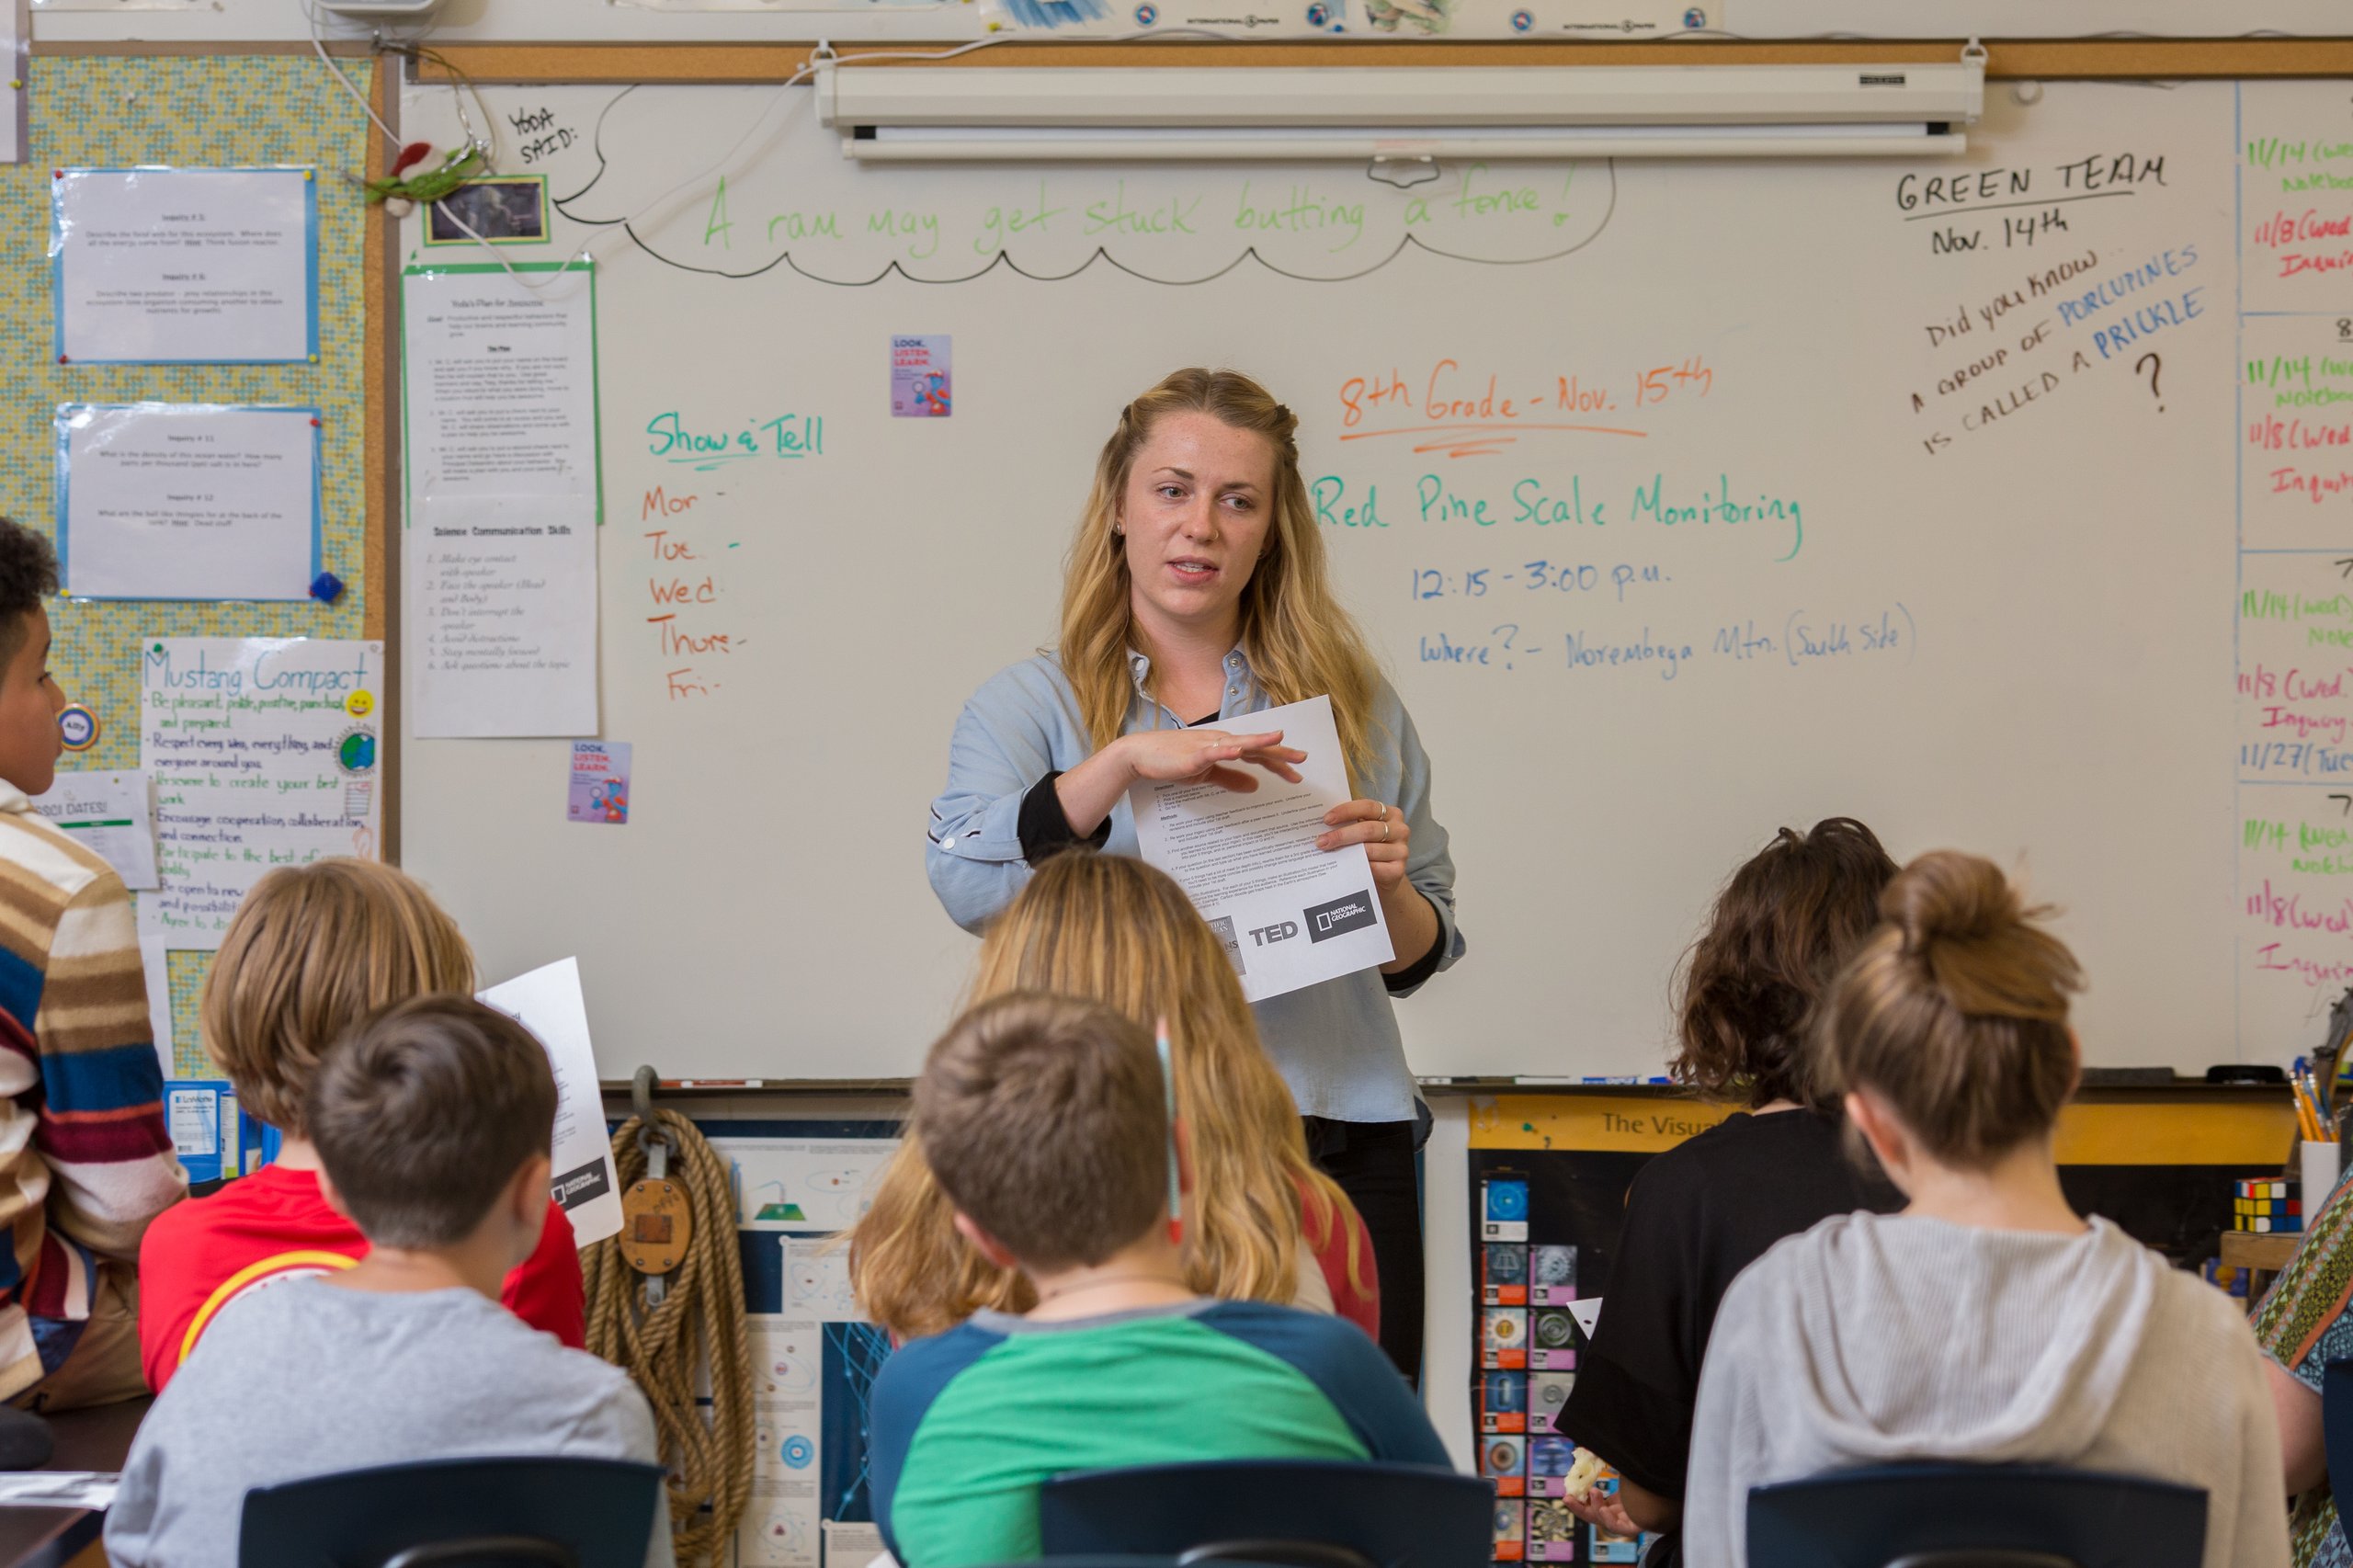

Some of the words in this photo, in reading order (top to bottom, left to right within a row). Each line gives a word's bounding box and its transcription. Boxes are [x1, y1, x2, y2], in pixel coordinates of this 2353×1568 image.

[508, 107, 553, 136] YODA
[521, 128, 578, 164] SAID:
[1897, 168, 2030, 210] GREEN
[2055, 153, 2166, 189] TEAM
[705, 175, 733, 249] A
[767, 210, 844, 244] ram
[868, 208, 939, 259] may
[974, 179, 1068, 256] get
[1083, 179, 1202, 236] stuck
[1234, 180, 1365, 254] butting
[1404, 199, 1432, 226] a
[1932, 228, 1988, 255] Nov.
[2004, 208, 2068, 247] 14th
[1911, 392, 1924, 414] A
[1938, 348, 2008, 395] GROUP
[2021, 319, 2052, 352] OF
[2057, 244, 2199, 327] PORCUPINES
[1925, 305, 1972, 347] Did
[1980, 290, 2026, 331] you
[1923, 432, 1951, 455] IS
[1961, 371, 2060, 432] CALLED
[2071, 350, 2091, 373] A
[2093, 285, 2206, 359] PRICKLE
[2135, 351, 2165, 414] ?
[1340, 368, 1413, 427] 8th
[1427, 358, 1519, 420] Grade
[1559, 374, 1617, 413] Nov.
[1635, 355, 1713, 407] 15th
[647, 411, 729, 456] Show
[759, 413, 823, 456] Tell
[434, 527, 468, 537] Science
[472, 526, 543, 537] Communication
[548, 524, 572, 536] Skills
[1312, 475, 1390, 528] Red
[1416, 473, 1498, 528] Pine
[1513, 475, 1607, 527] Scale
[1631, 472, 1803, 562] Monitoring
[1412, 568, 1491, 602] 12:15
[1524, 559, 1599, 593] 3:00
[1565, 626, 1694, 682] Norembega
[143, 649, 243, 698] Mustang
[253, 650, 369, 696] Compact
[153, 732, 195, 751] Respect
[196, 739, 224, 755] every
[199, 754, 239, 769] around
[209, 772, 222, 789] to
[229, 773, 269, 790] create
[277, 778, 310, 794] your
[156, 808, 212, 827] Encourage
[224, 847, 237, 862] to
[243, 848, 263, 864] the
[268, 848, 295, 864] best
[301, 847, 321, 864] of
[177, 883, 206, 897] open
[1330, 903, 1358, 917] NATIONAL
[1331, 905, 1367, 922] GEOGRAPHIC
[1248, 920, 1299, 948] TED
[1602, 1112, 1645, 1134] The
[564, 1172, 592, 1187] NATIONAL
[565, 1176, 602, 1196] GEOGRAPHIC
